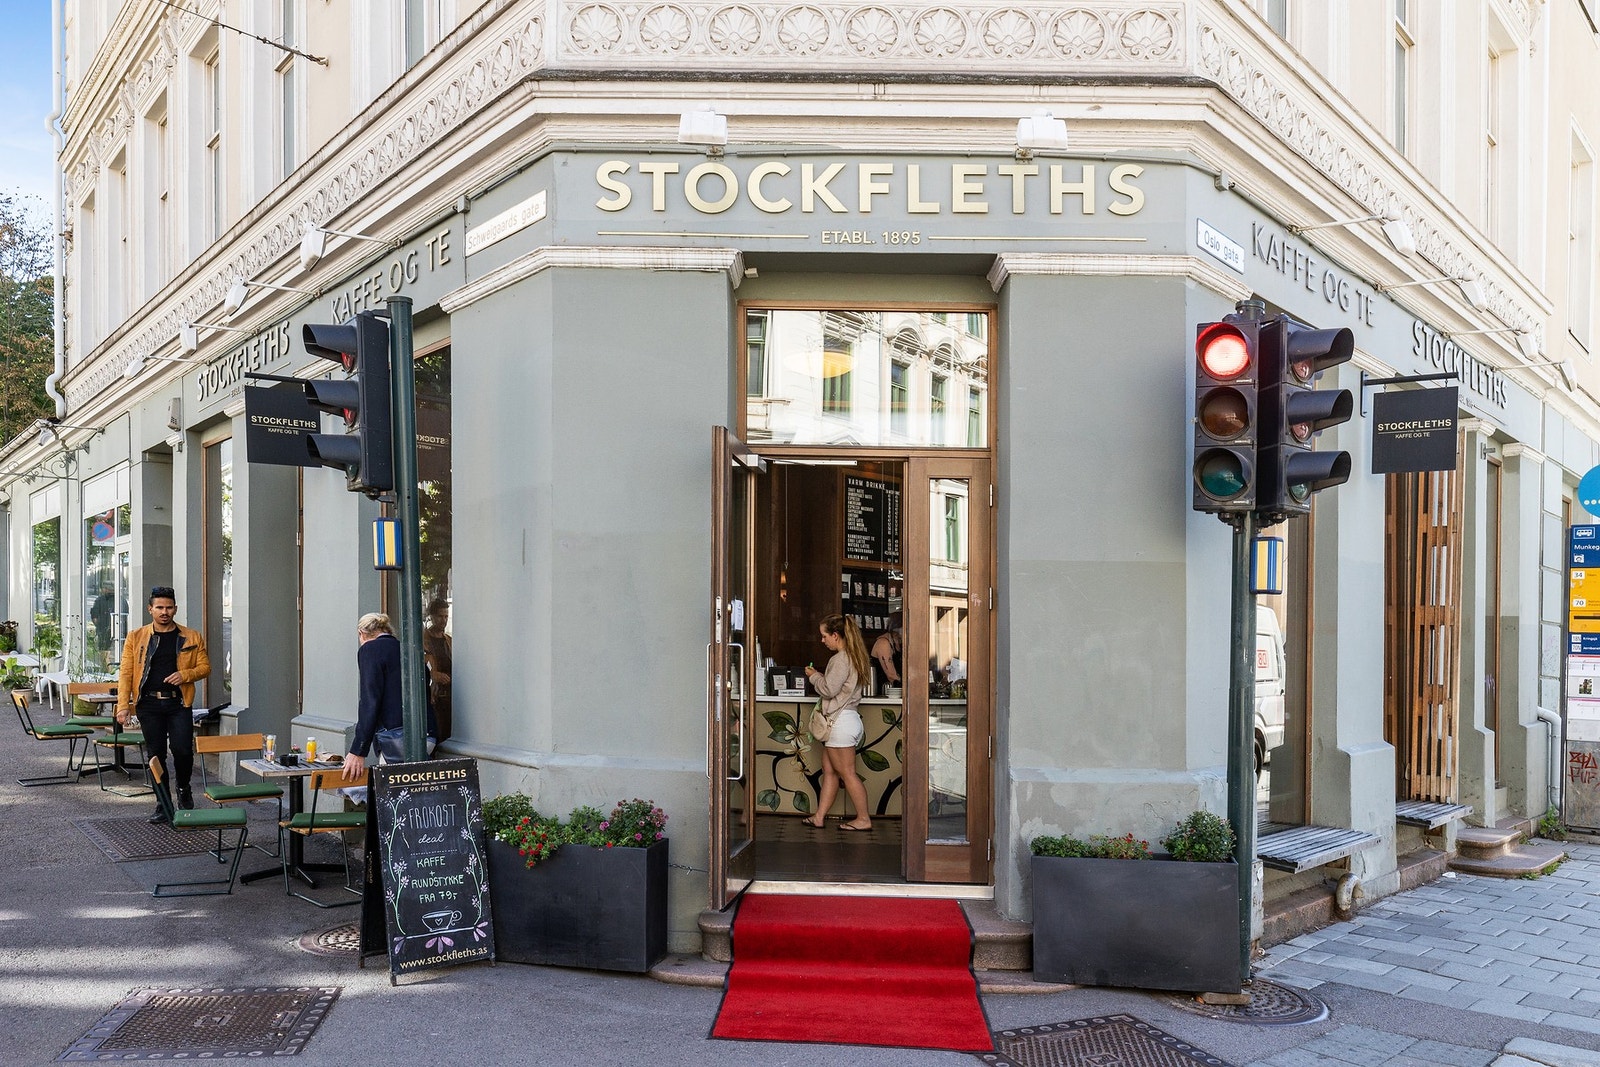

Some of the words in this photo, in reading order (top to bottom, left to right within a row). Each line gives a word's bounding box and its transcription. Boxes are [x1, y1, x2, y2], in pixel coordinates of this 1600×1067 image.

[595, 161, 1146, 216] STOCKFLETHS
[468, 213, 517, 250] Schweigaards
[521, 203, 541, 224] gate
[821, 230, 876, 245] ETABL.
[882, 231, 921, 246] 1895
[1204, 230, 1220, 251] Oslo
[1223, 243, 1239, 264] gate
[332, 271, 383, 325] KAFFE
[388, 250, 418, 293] OG
[425, 228, 450, 271] TE
[1253, 221, 1317, 293] KAFFE
[1323, 269, 1350, 312] OG
[1356, 288, 1375, 327] TE
[197, 320, 290, 402] STOCKFLETHS
[1413, 320, 1508, 409] STOCKFLETHS
[251, 415, 317, 428] STOCKFLETHS
[1377, 418, 1452, 431] STOCKFLETHS
[388, 769, 467, 784] STOCKFLETHS
[408, 804, 456, 829] FROKOST
[418, 833, 444, 844] deal
[416, 855, 446, 868] KAFFE
[411, 874, 464, 889] RUNDSTYKKE
[419, 892, 436, 904] FRA
[400, 945, 488, 969] www.stockfleths.as
